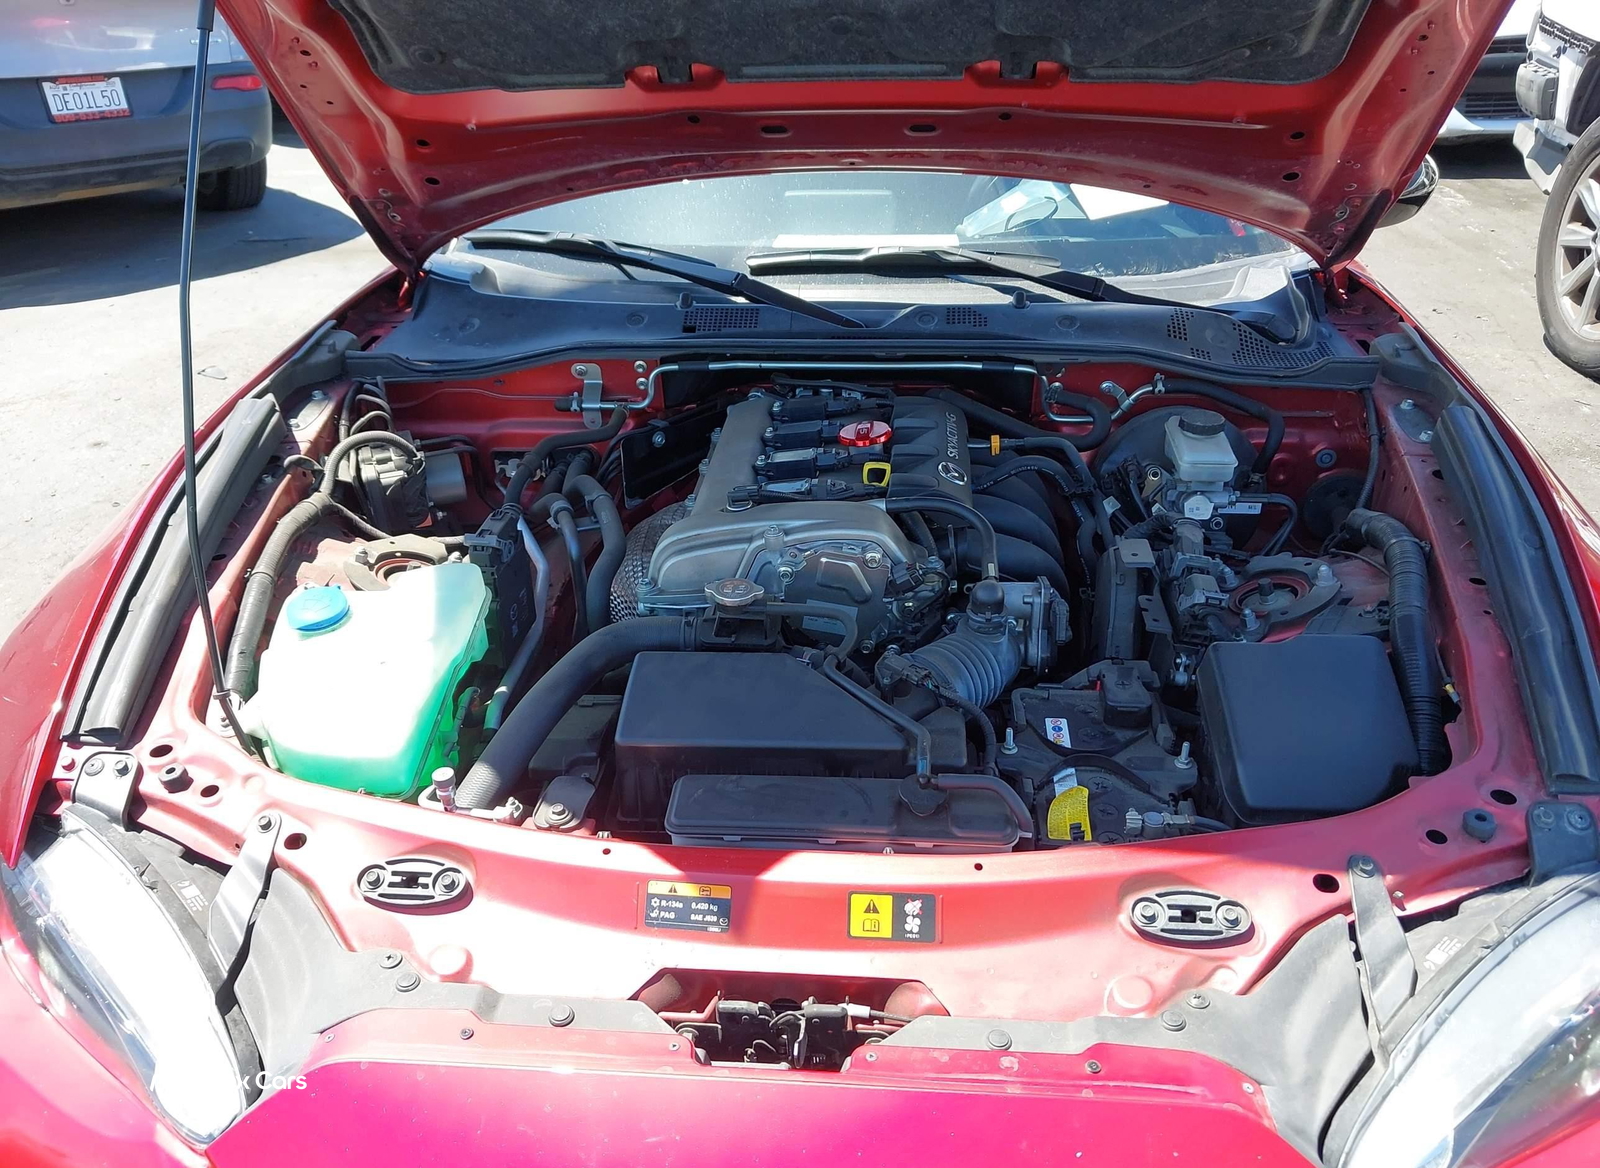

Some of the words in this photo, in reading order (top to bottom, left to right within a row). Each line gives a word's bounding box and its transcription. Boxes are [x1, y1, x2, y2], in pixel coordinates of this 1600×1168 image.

[52, 88, 121, 112] DE01L50
[691, 902, 709, 911] 0.420
[710, 903, 718, 912] kg
[660, 911, 676, 919] PAG
[690, 913, 703, 921] SAE
